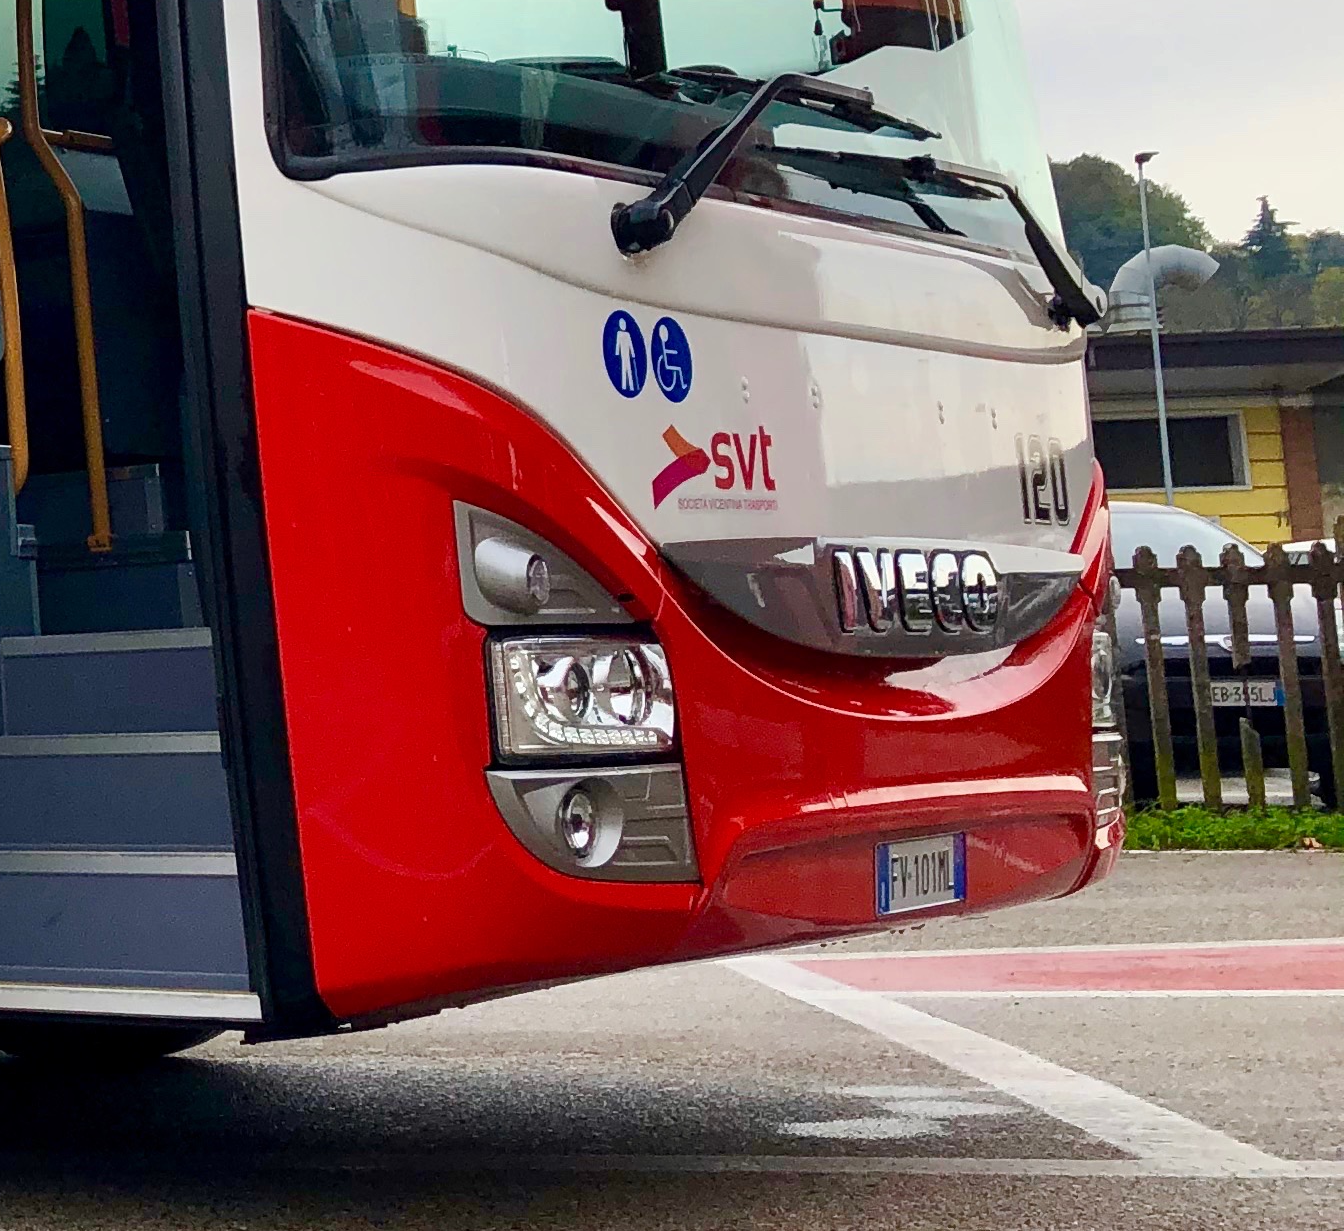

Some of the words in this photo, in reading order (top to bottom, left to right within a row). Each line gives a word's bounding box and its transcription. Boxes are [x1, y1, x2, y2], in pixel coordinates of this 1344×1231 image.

[710, 425, 777, 491] svt
[1014, 432, 1071, 526] 120
[832, 547, 999, 636] IVECO
